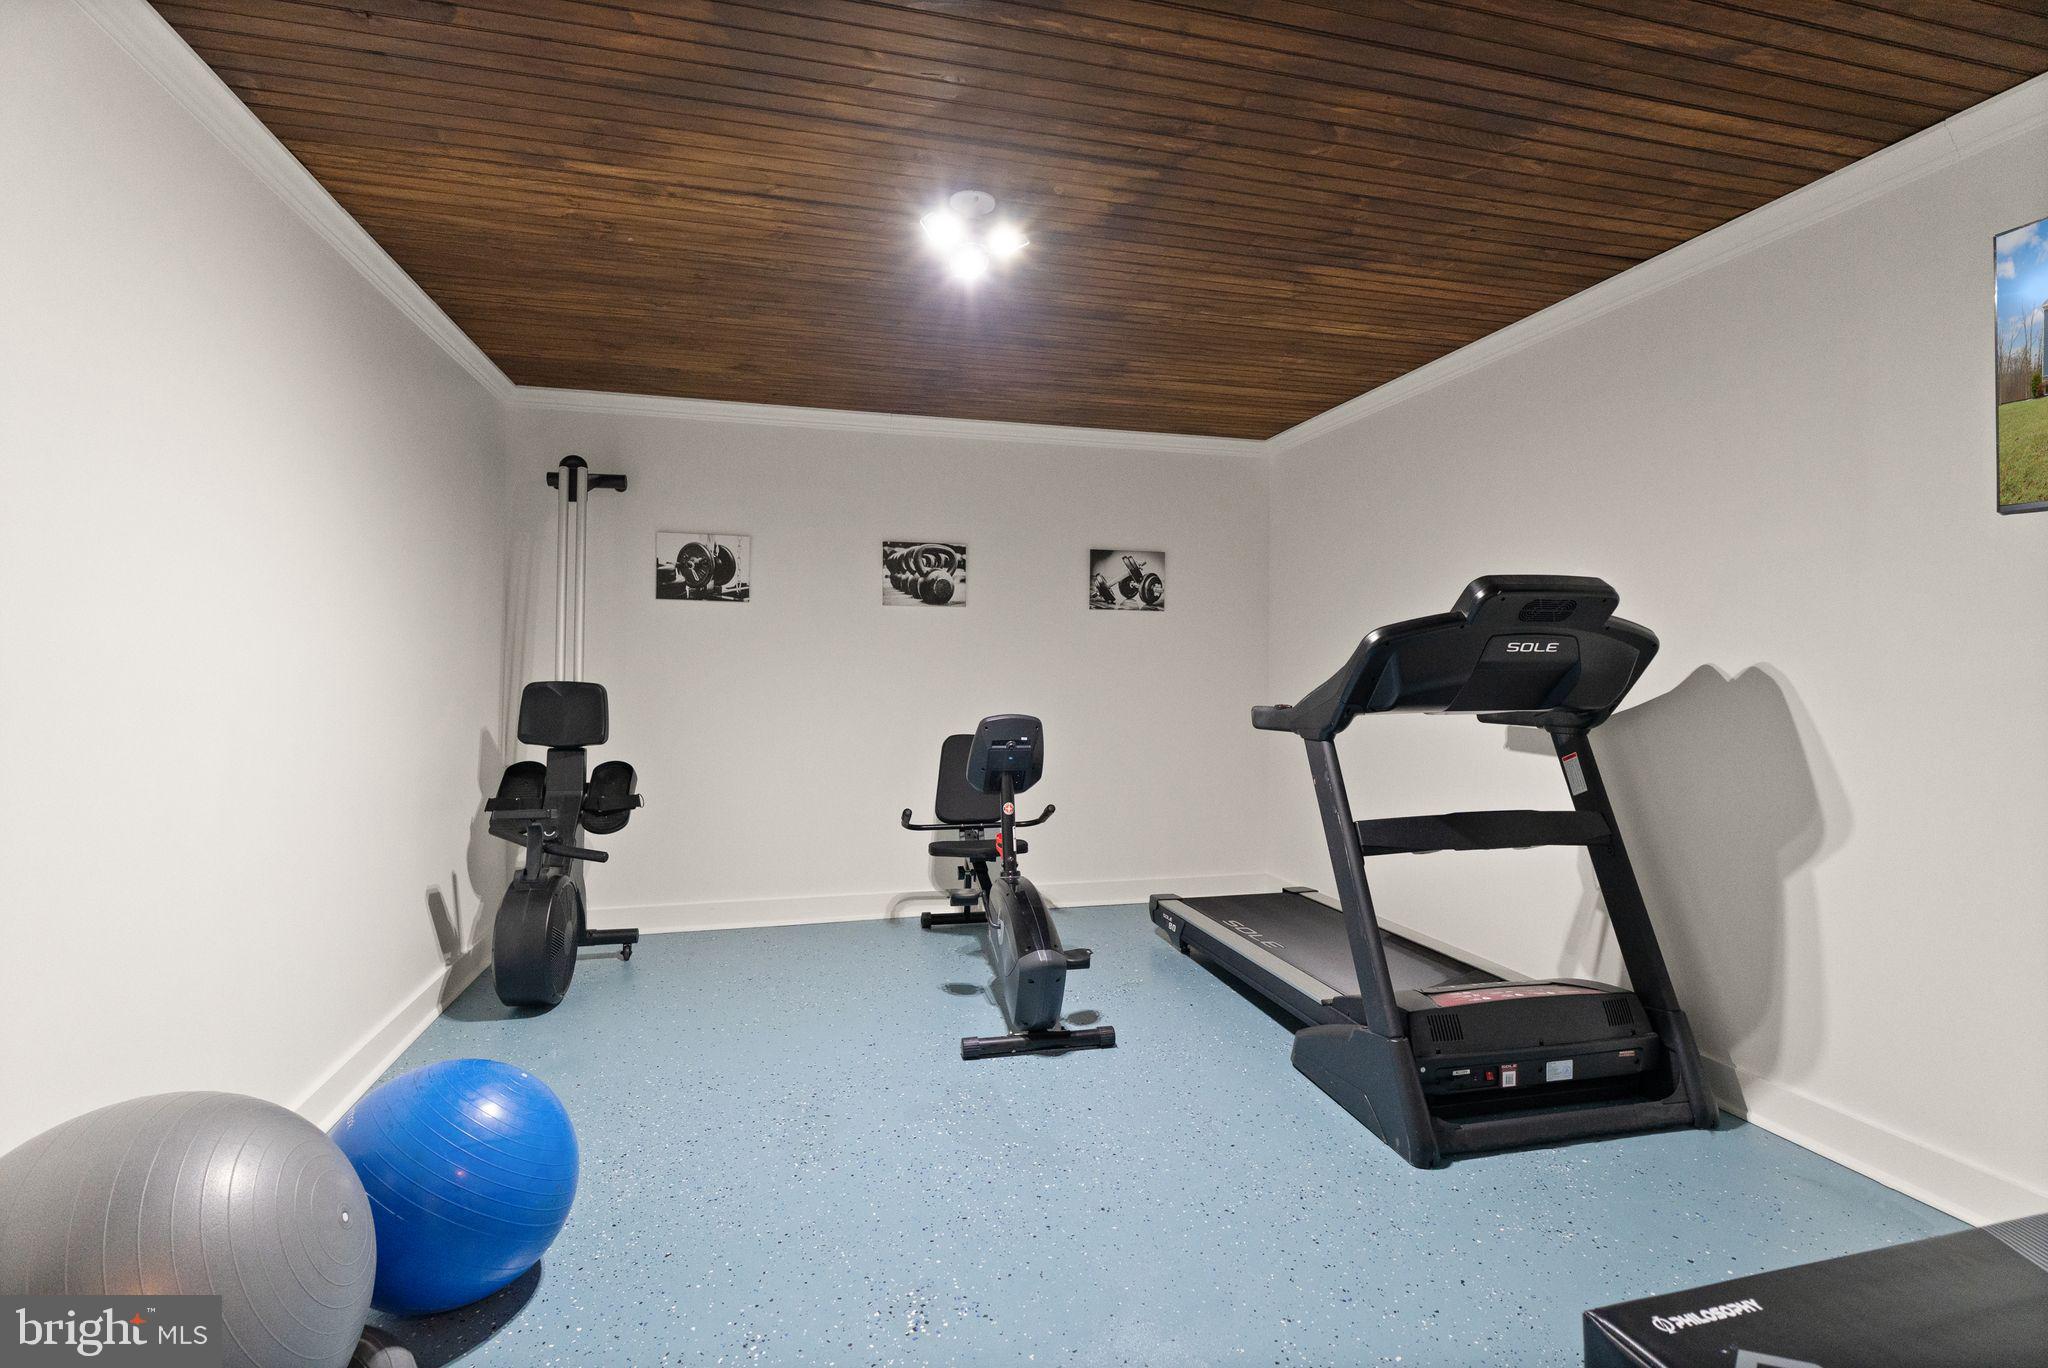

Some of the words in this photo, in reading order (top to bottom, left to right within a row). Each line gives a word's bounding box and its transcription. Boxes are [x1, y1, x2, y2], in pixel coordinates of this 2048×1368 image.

[1506, 642, 1560, 653] SOLE
[1222, 919, 1285, 949] SOLE
[1668, 1298, 1763, 1329] PHILOSOPHY
